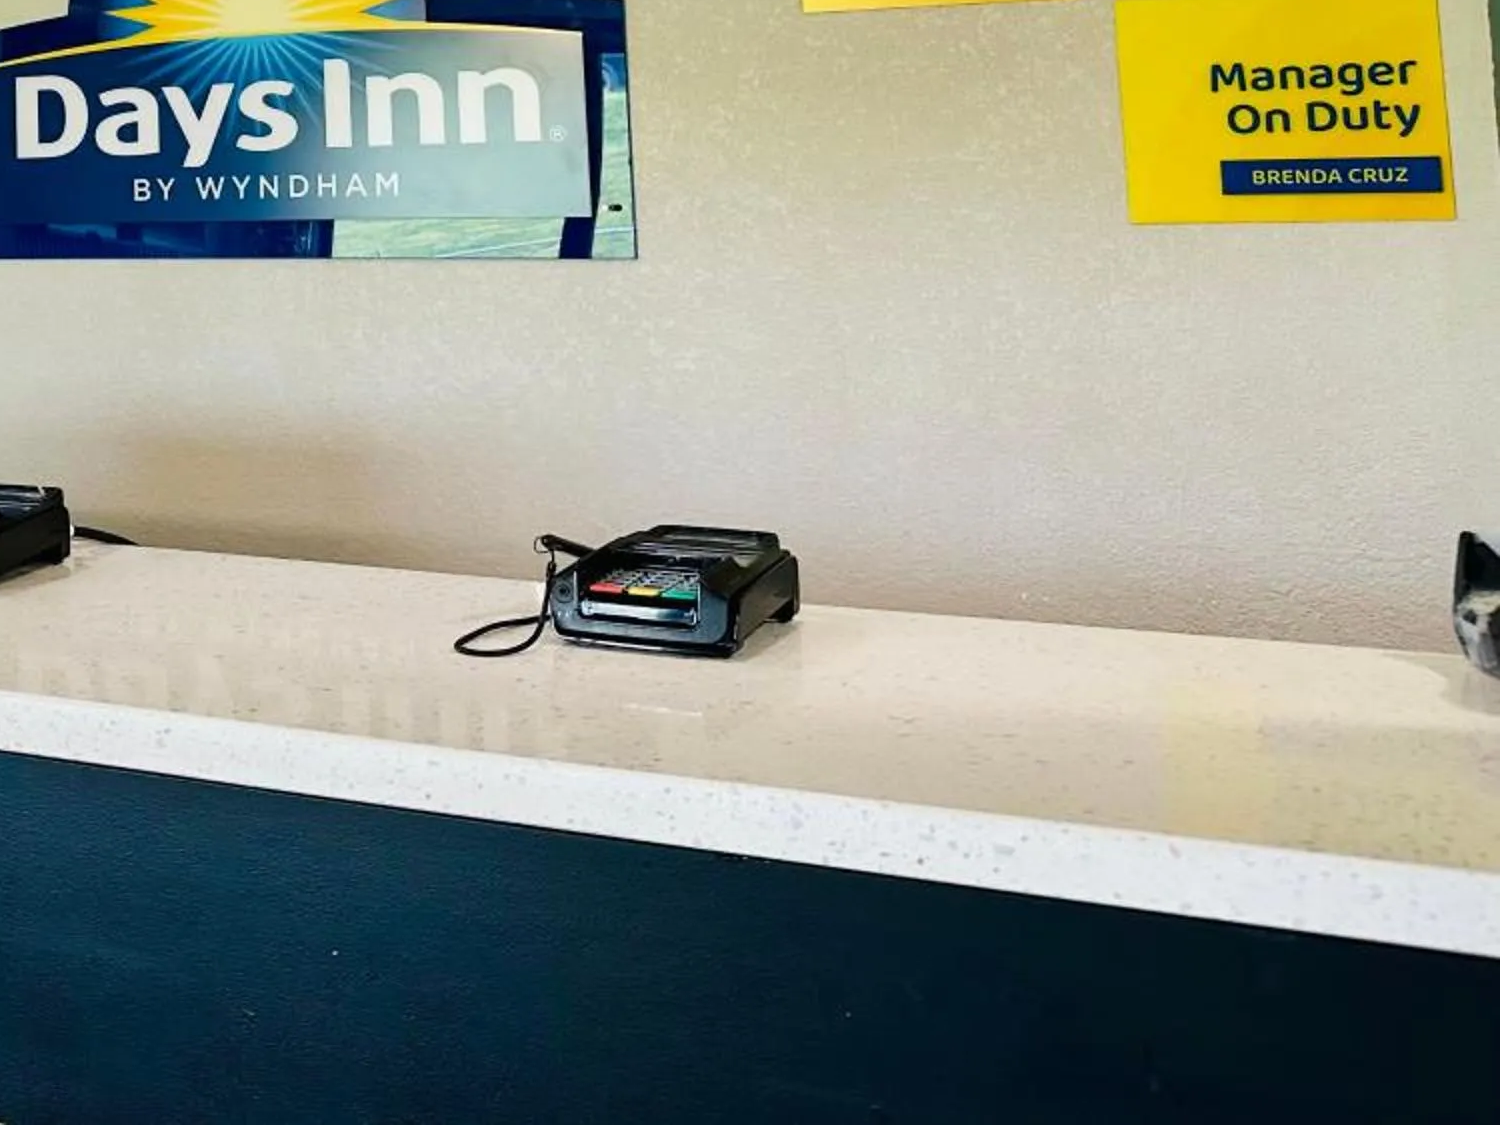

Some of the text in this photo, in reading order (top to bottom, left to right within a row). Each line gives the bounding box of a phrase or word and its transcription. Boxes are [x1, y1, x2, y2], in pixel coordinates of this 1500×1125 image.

[1211, 60, 1417, 96] Manager
[14, 58, 542, 168] Days Inn
[1227, 100, 1421, 138] On Duty
[133, 172, 399, 201] BY WYNDHAM
[1252, 167, 1409, 186] BRENDA CRUZ
